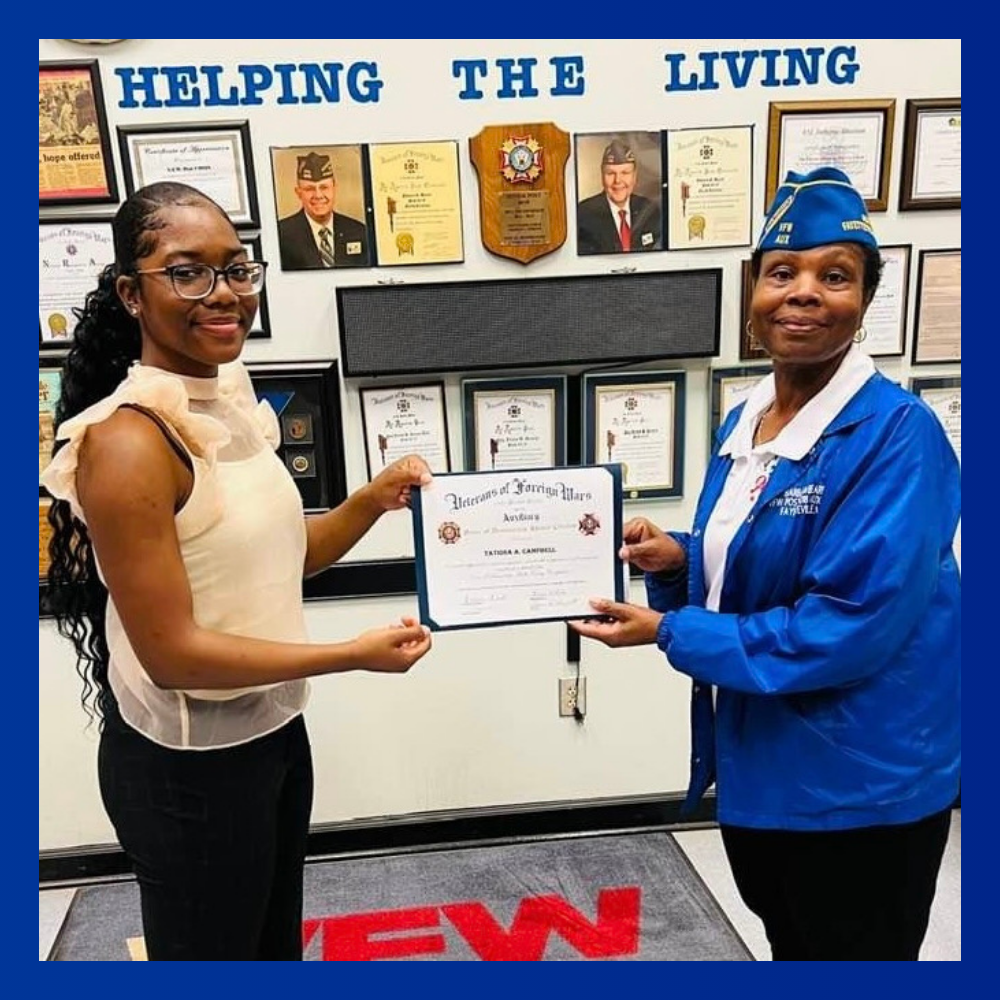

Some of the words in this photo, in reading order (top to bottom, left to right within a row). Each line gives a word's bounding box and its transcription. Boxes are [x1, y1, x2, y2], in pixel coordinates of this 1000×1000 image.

[114, 61, 384, 108] HELPING
[452, 55, 586, 100] THE
[664, 45, 862, 92] LIVING
[43, 153, 68, 163] hope
[445, 487, 498, 511] Veterans
[500, 482, 510, 495] of
[512, 478, 559, 498] Foreign
[556, 482, 592, 501] Wars
[302, 886, 642, 961] FW
